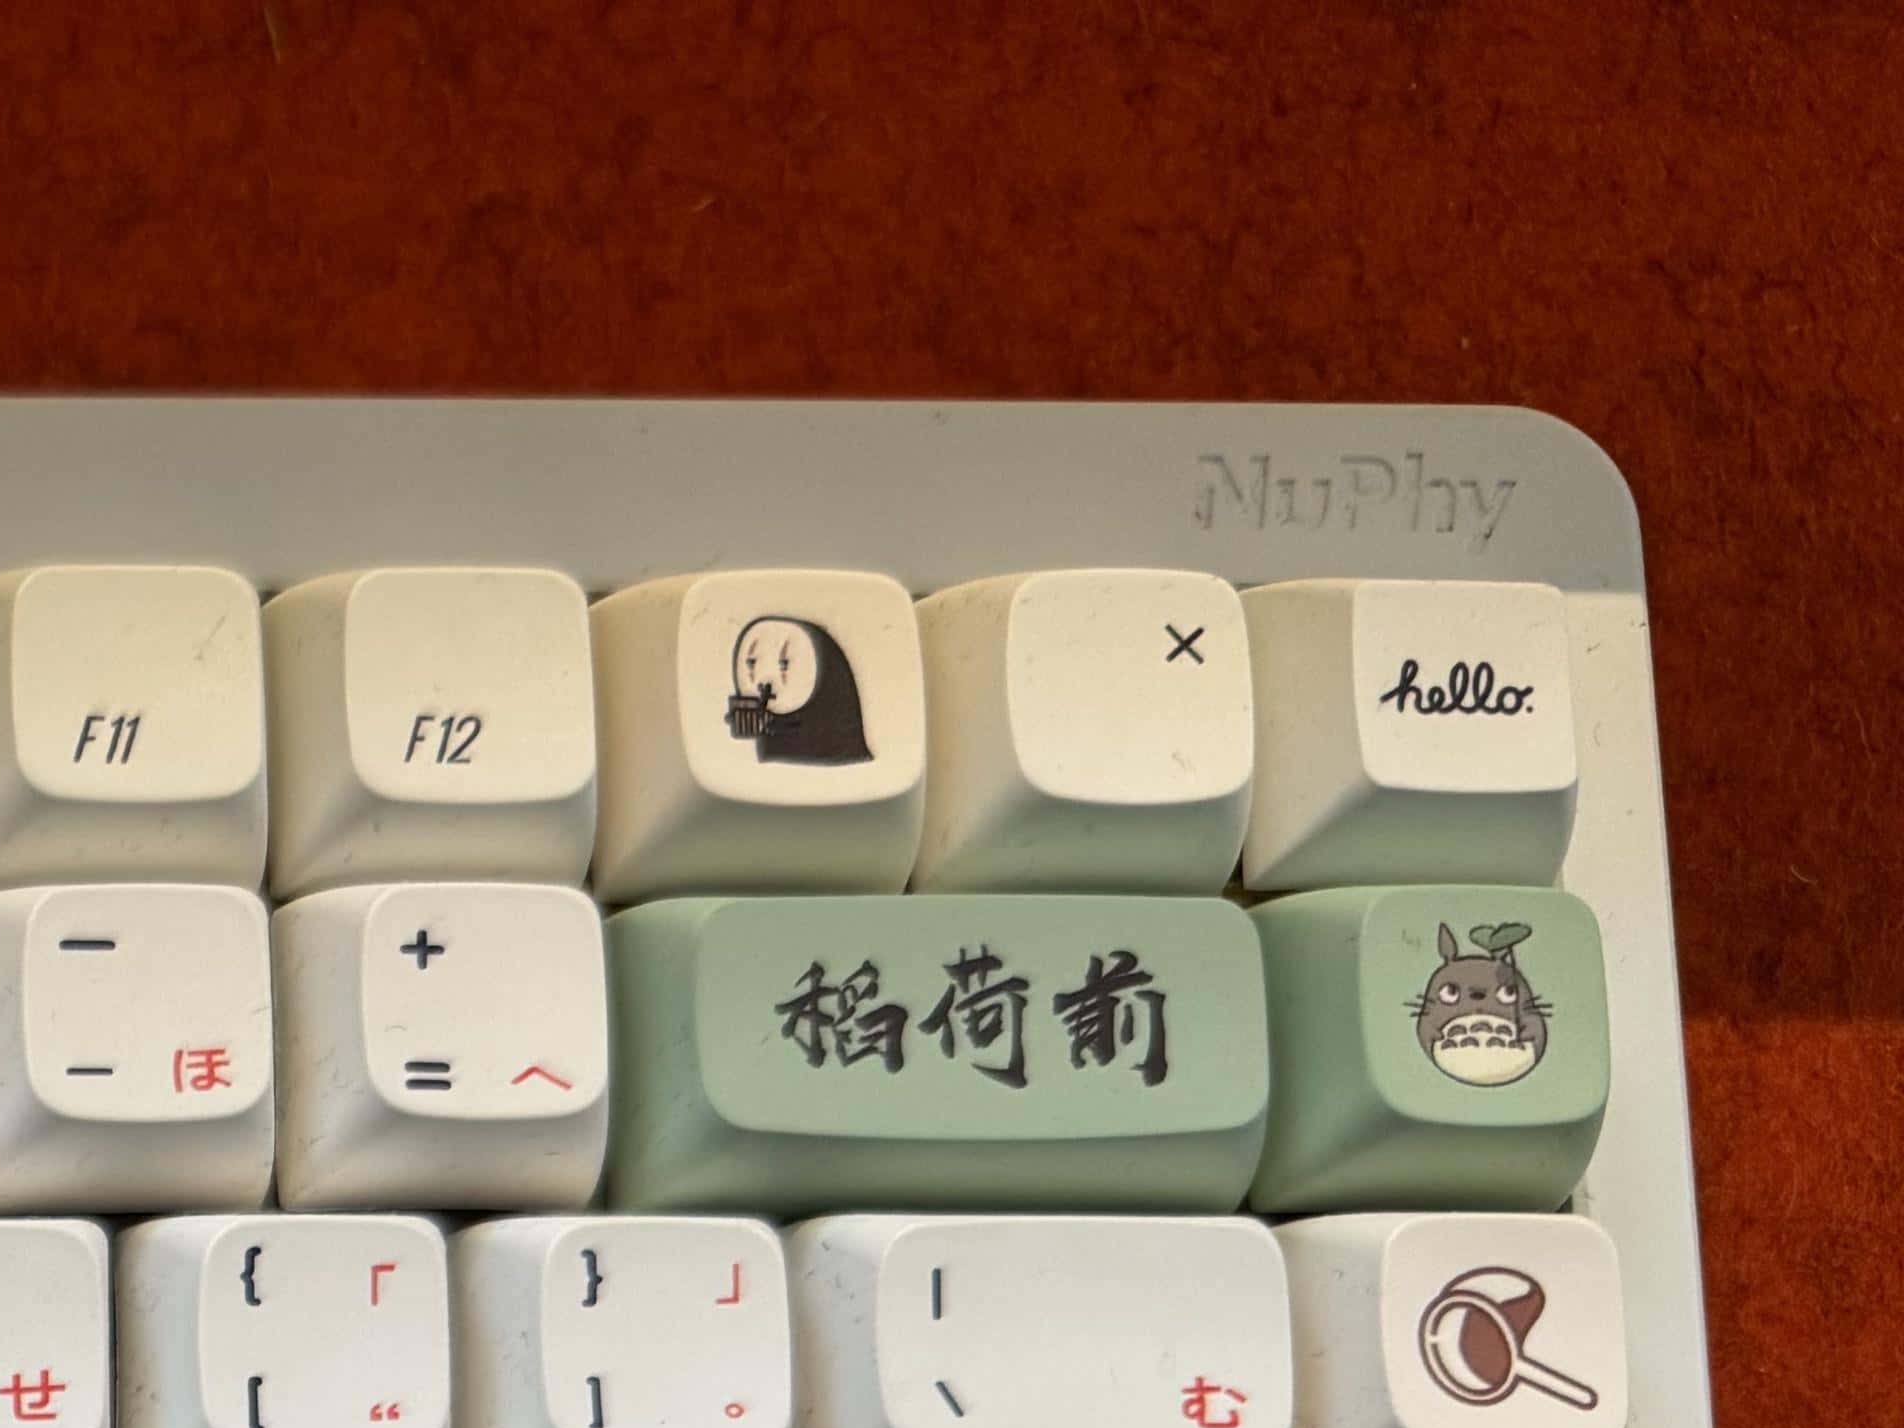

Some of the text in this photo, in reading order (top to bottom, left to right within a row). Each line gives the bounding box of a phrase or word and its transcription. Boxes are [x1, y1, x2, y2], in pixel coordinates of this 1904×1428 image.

[1190, 450, 1518, 553] NuPhy
[1378, 657, 1535, 717] hello.
[72, 713, 143, 765] F11
[403, 713, 484, 765] F12
[398, 928, 447, 971] +
[773, 942, 1170, 1090] 稲荷前
[171, 1045, 230, 1093] ほ
[403, 1059, 453, 1092] =
[238, 1244, 264, 1308] {
[580, 1247, 605, 1308] }
